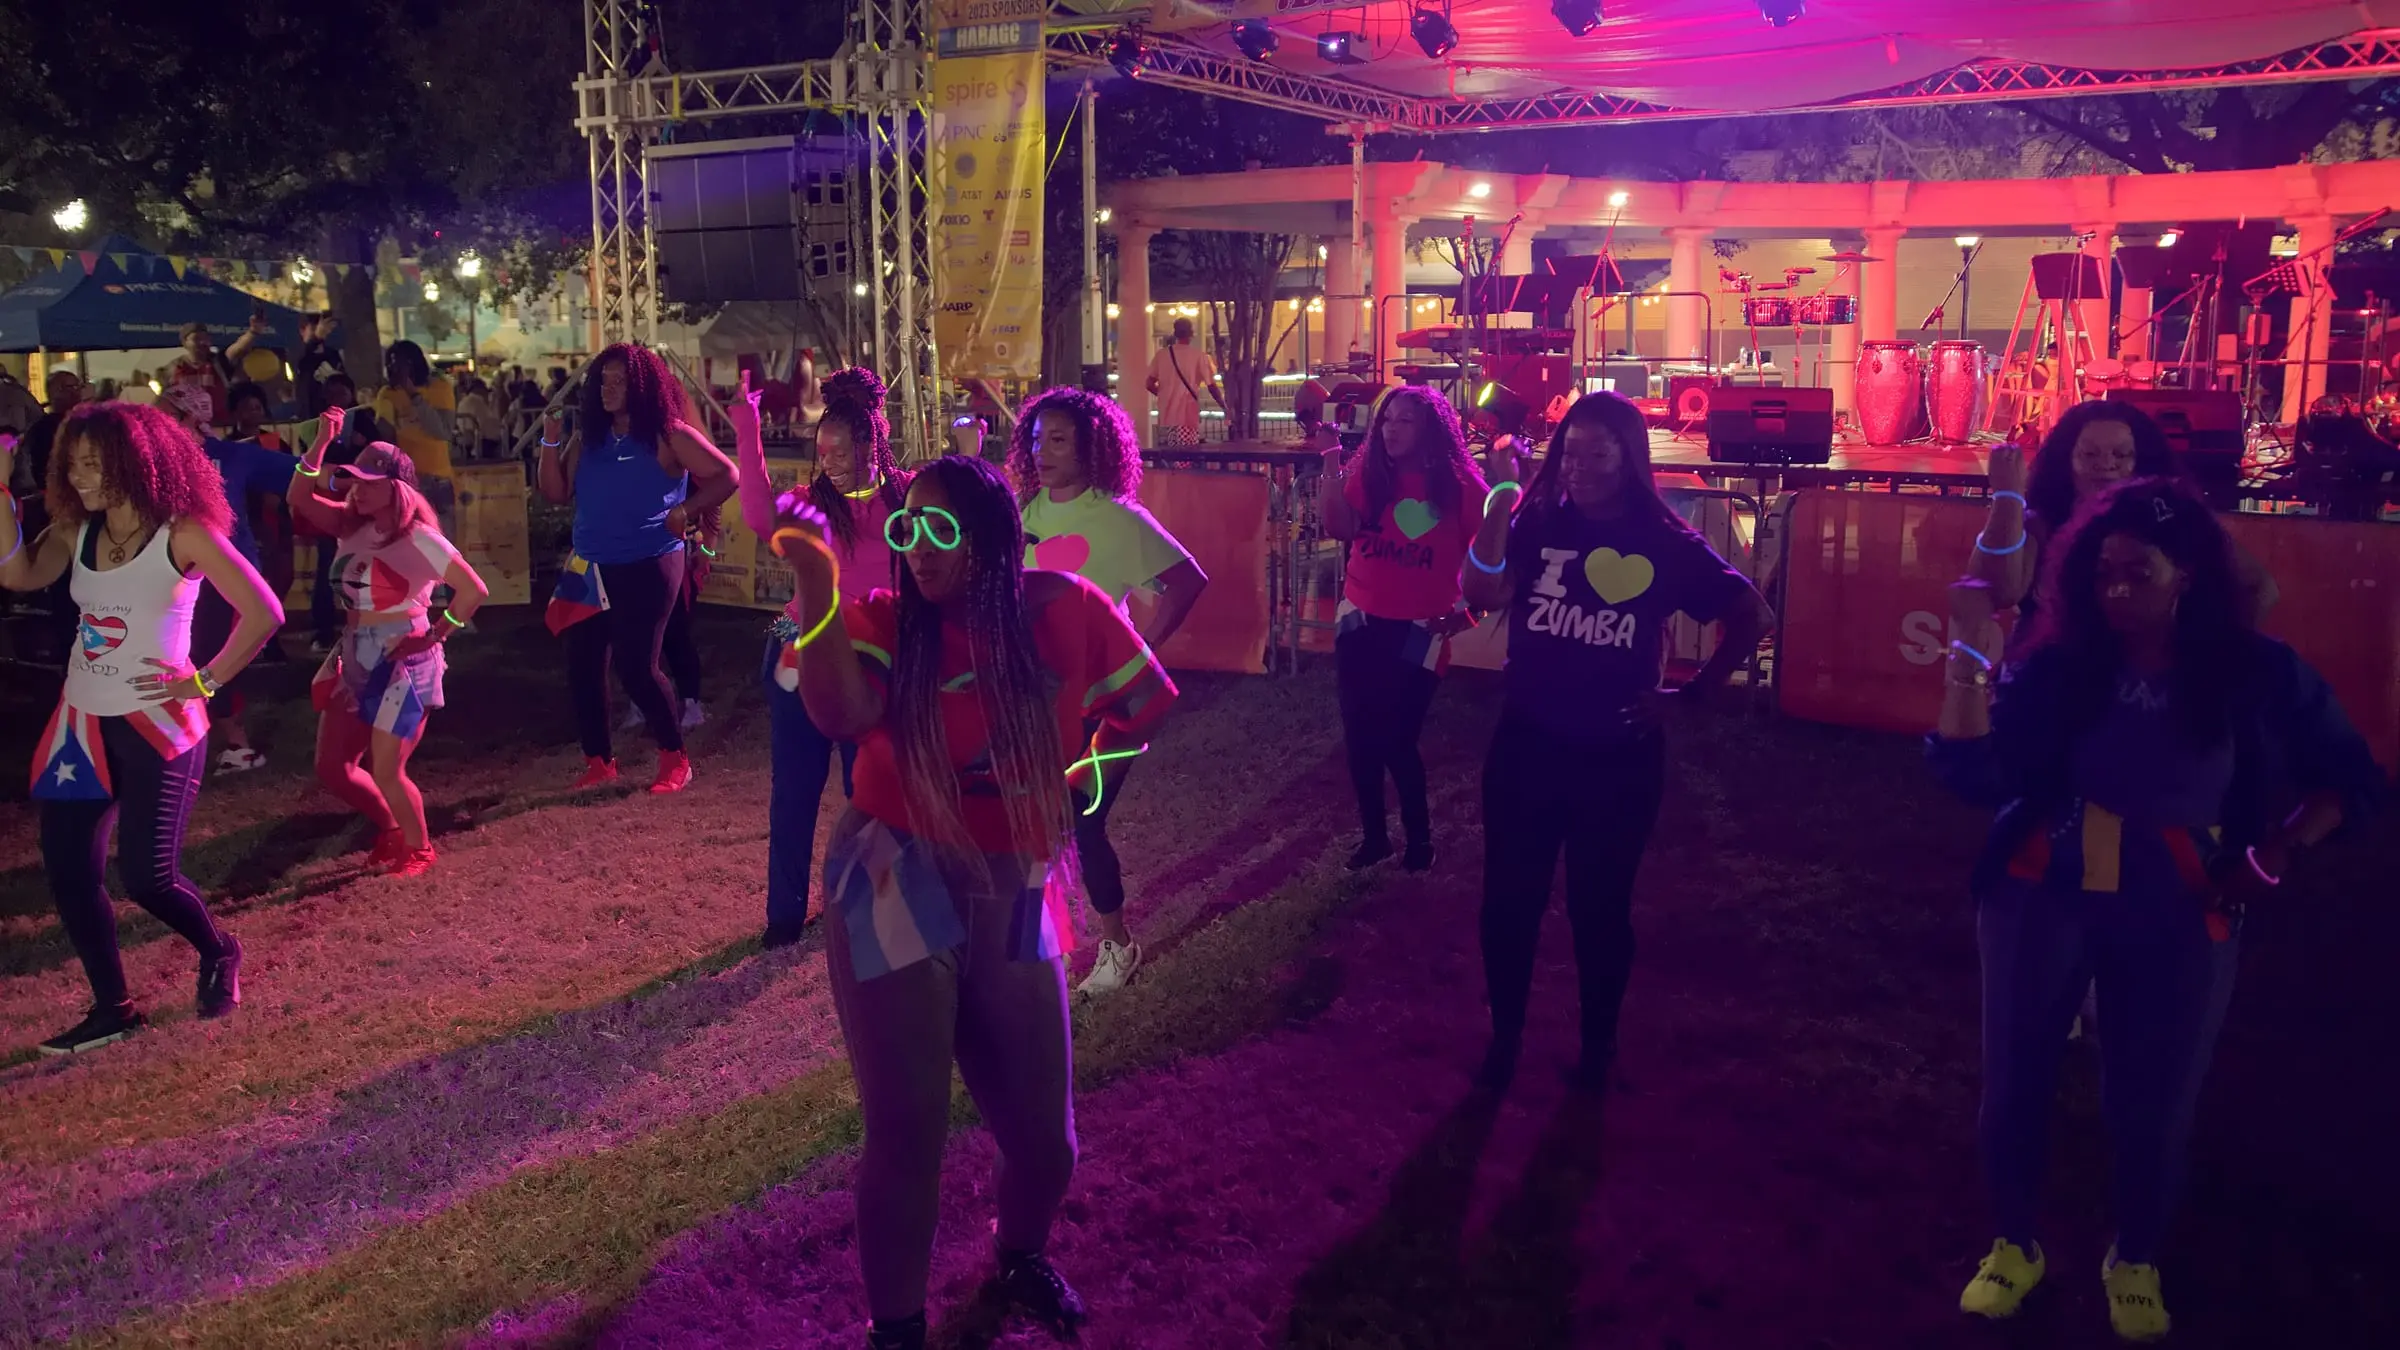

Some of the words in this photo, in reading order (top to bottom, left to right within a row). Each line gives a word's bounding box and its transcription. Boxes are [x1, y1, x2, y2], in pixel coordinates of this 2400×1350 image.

[969, 3, 990, 20] 2023
[992, 0, 1041, 18] SPONSORS
[946, 77, 998, 106] spire
[953, 124, 987, 141] PNC
[960, 190, 982, 200] AT&T
[994, 188, 1032, 200] AIUS
[941, 302, 973, 311] AARP
[1355, 534, 1434, 571] ZUMBA
[1532, 547, 1579, 598] I
[113, 604, 132, 616] my
[1527, 597, 1636, 649] ZUMBA
[72, 660, 119, 677] OOD
[2116, 1293, 2155, 1309] LOVE
